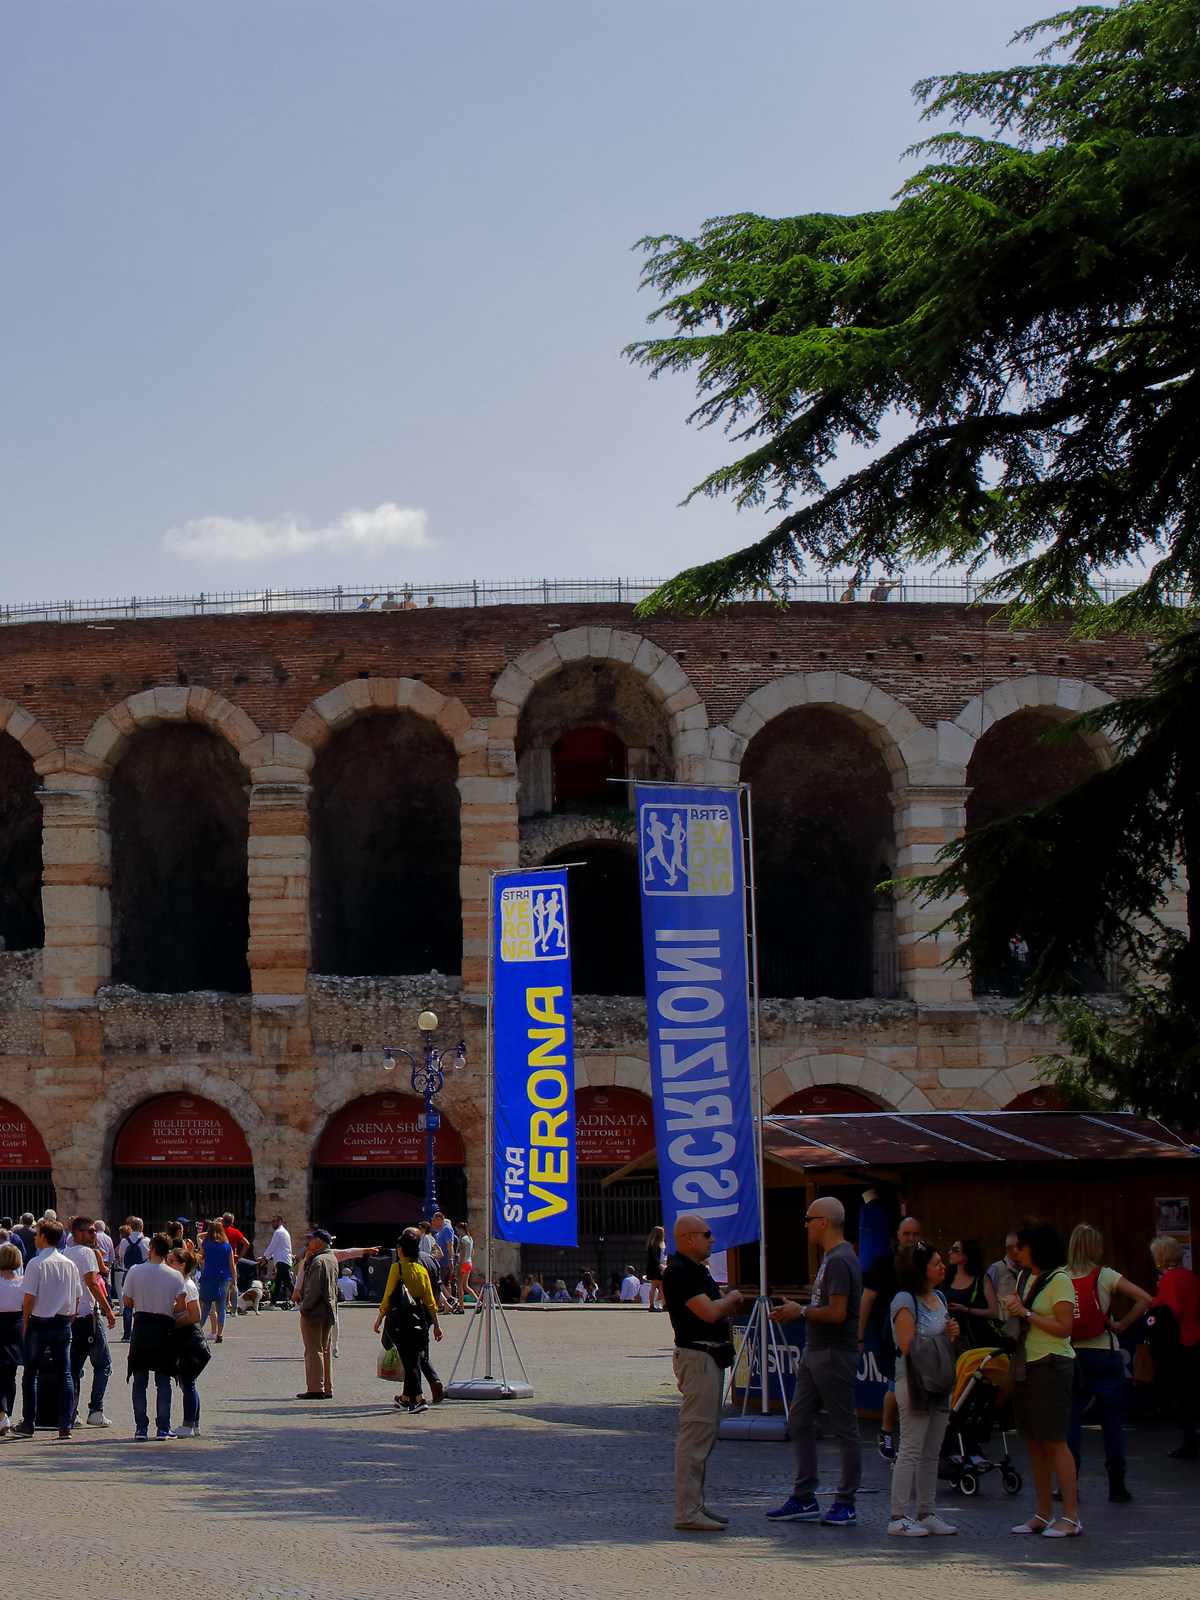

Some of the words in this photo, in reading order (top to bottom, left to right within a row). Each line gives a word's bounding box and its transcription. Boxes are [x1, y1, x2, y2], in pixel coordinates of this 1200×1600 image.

[502, 889, 529, 901] STRA
[503, 901, 529, 919] VE
[503, 921, 530, 939] RO
[502, 940, 532, 958] NA
[526, 986, 569, 1223] VERONA
[153, 1119, 221, 1128] BIGLIETTERIA
[576, 1115, 648, 1126] ADINATA
[151, 1128, 187, 1136] TICKET
[188, 1128, 224, 1136] OFFICE
[346, 1123, 394, 1133] ARENA
[397, 1122, 425, 1133] SHO
[623, 1128, 632, 1137] D
[21, 1139, 28, 1147] 8
[343, 1137, 387, 1145] Cancello
[397, 1137, 422, 1145] Gate
[627, 1138, 636, 1146] 11
[503, 1146, 526, 1223] STRA
[732, 1327, 747, 1337] STR
